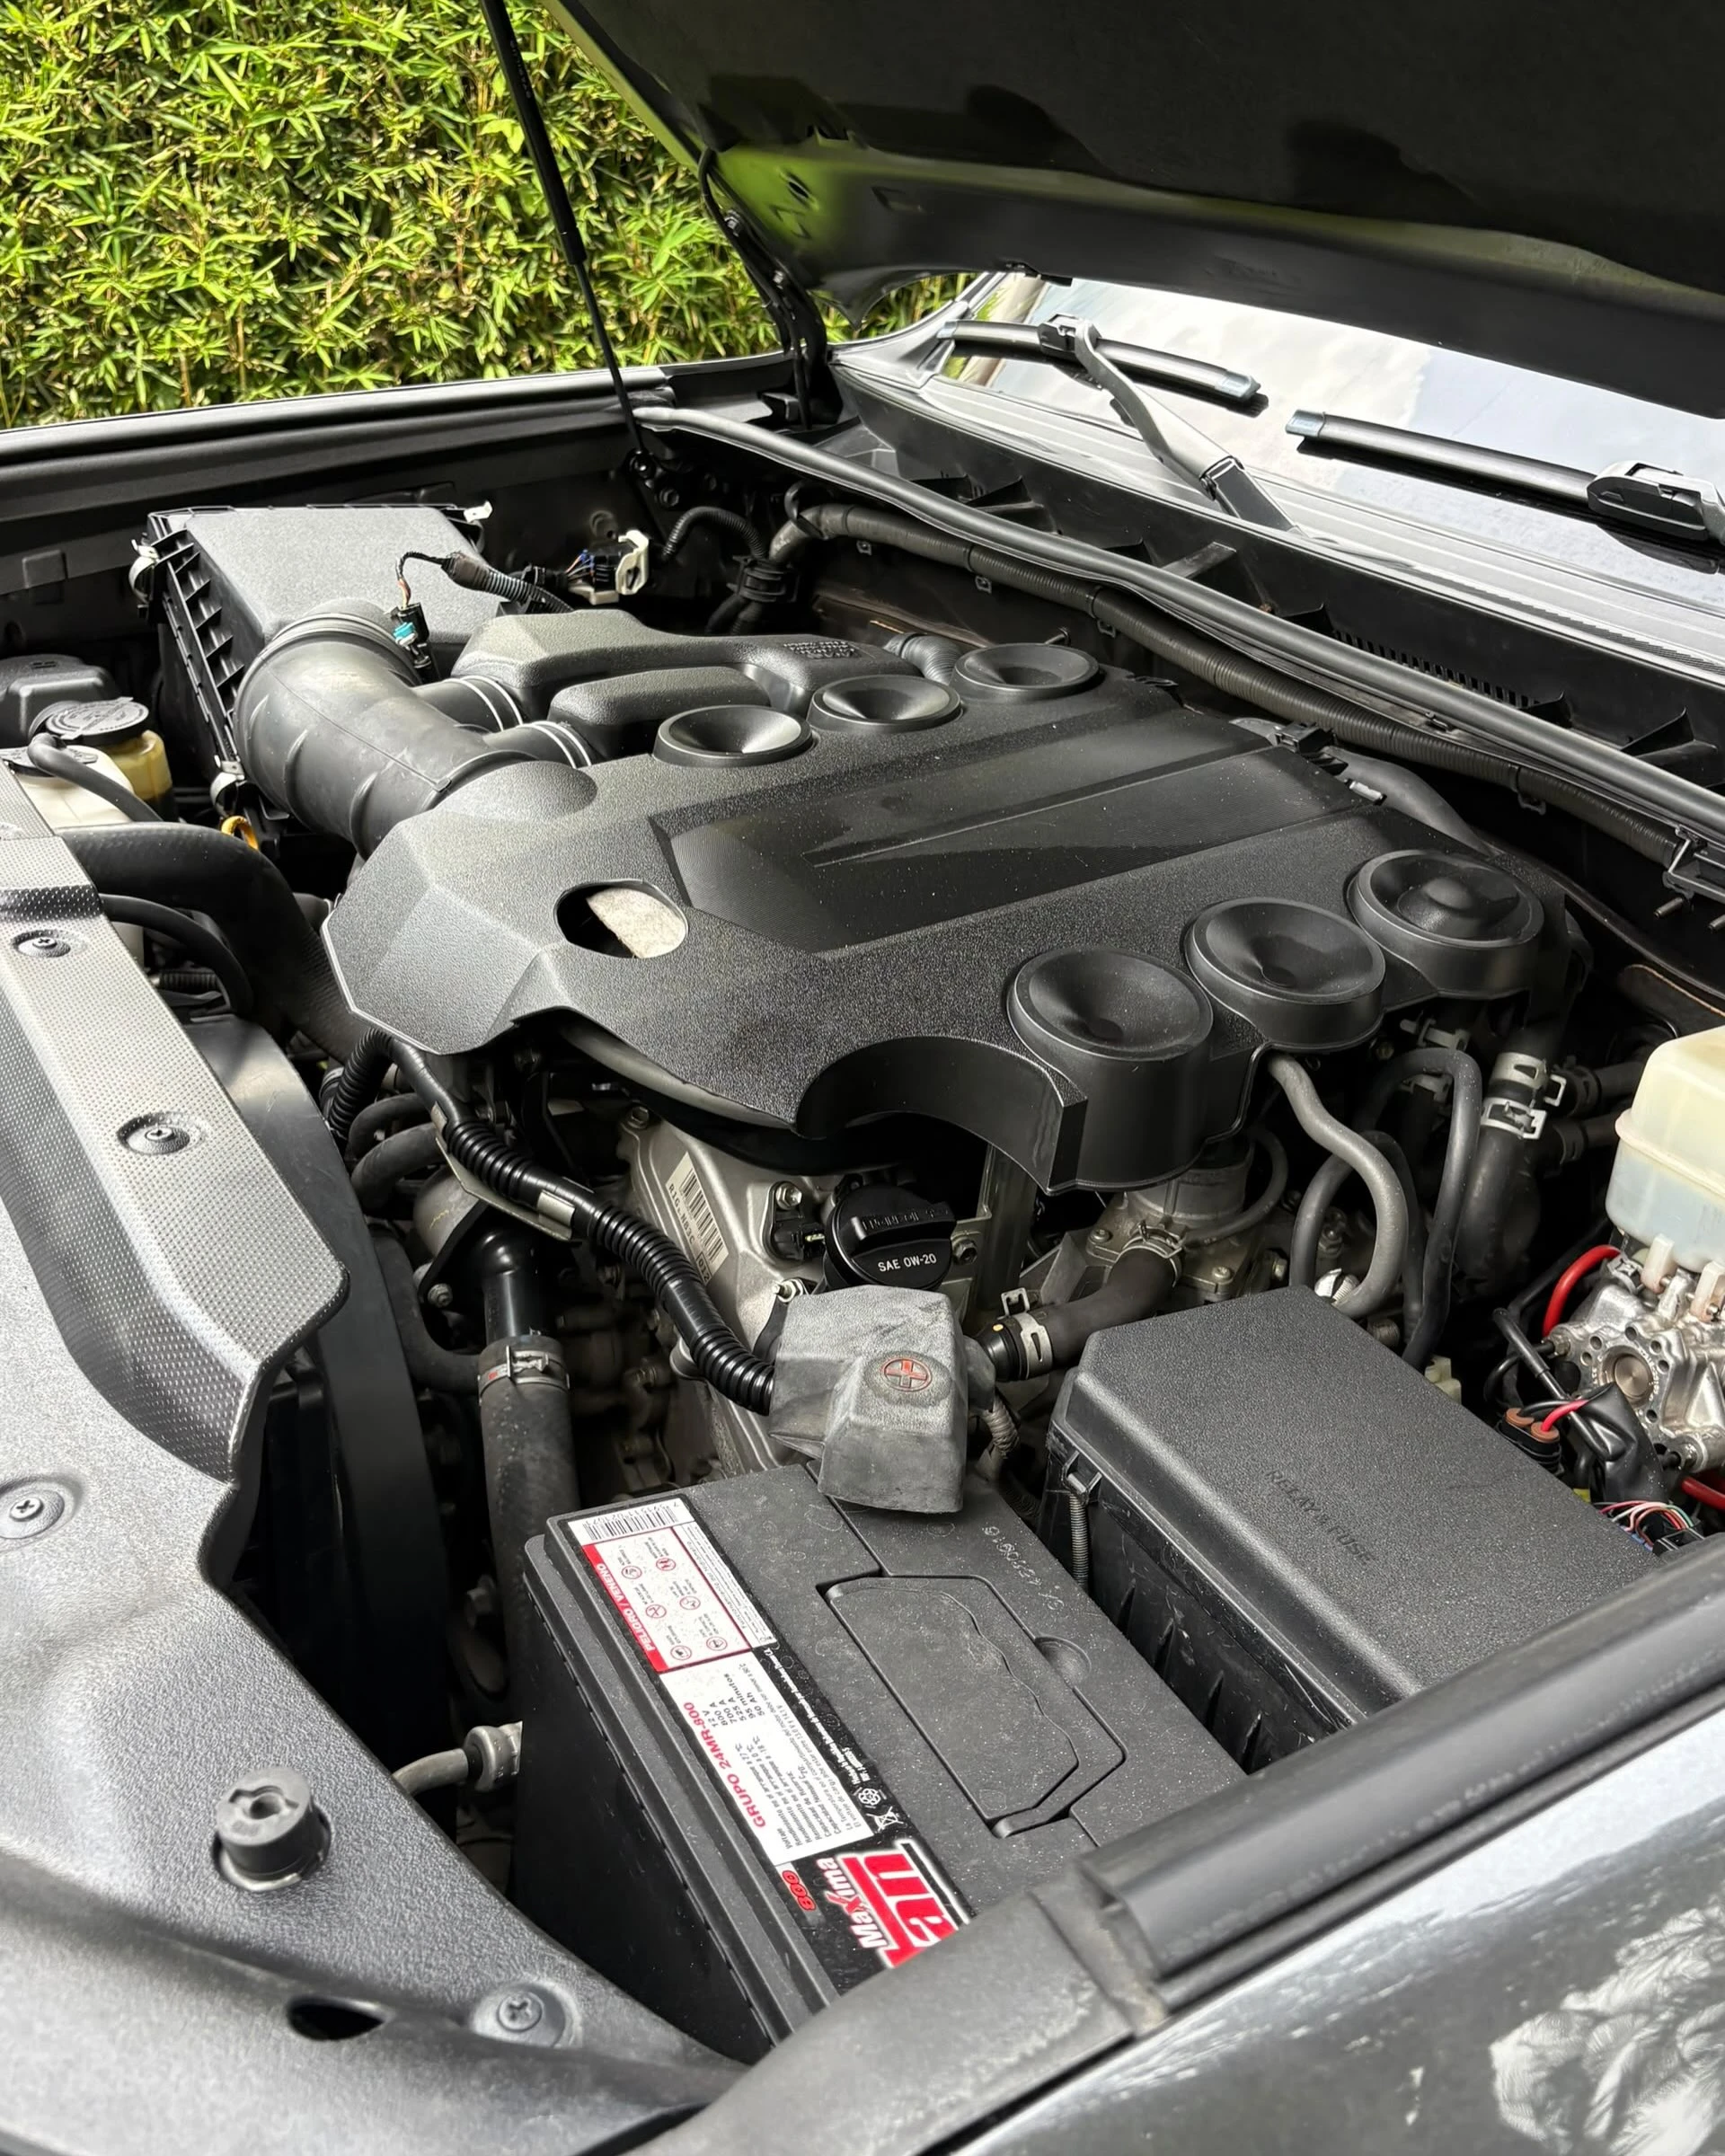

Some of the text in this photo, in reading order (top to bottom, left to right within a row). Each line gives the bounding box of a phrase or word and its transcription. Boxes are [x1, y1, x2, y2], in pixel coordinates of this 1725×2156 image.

[878, 1253, 937, 1272] SAE 0W-20
[1265, 1470, 1322, 1512] RELAY
[1327, 1525, 1378, 1564] FUSE
[595, 1562, 626, 1603] VENENO
[622, 1607, 656, 1651] PELIGRO
[722, 1673, 756, 1719] 95 minutos
[744, 1691, 765, 1716] 50 Ah
[707, 1717, 719, 1727] 12
[712, 1710, 729, 1726] 800
[721, 1707, 738, 1724] 700
[731, 1704, 747, 1721] 525
[682, 1701, 767, 1828] GRUPO 24MR-800
[807, 1805, 833, 1837] Capacidad
[817, 1802, 842, 1834] Capacidad
[782, 1869, 817, 1911] 800
